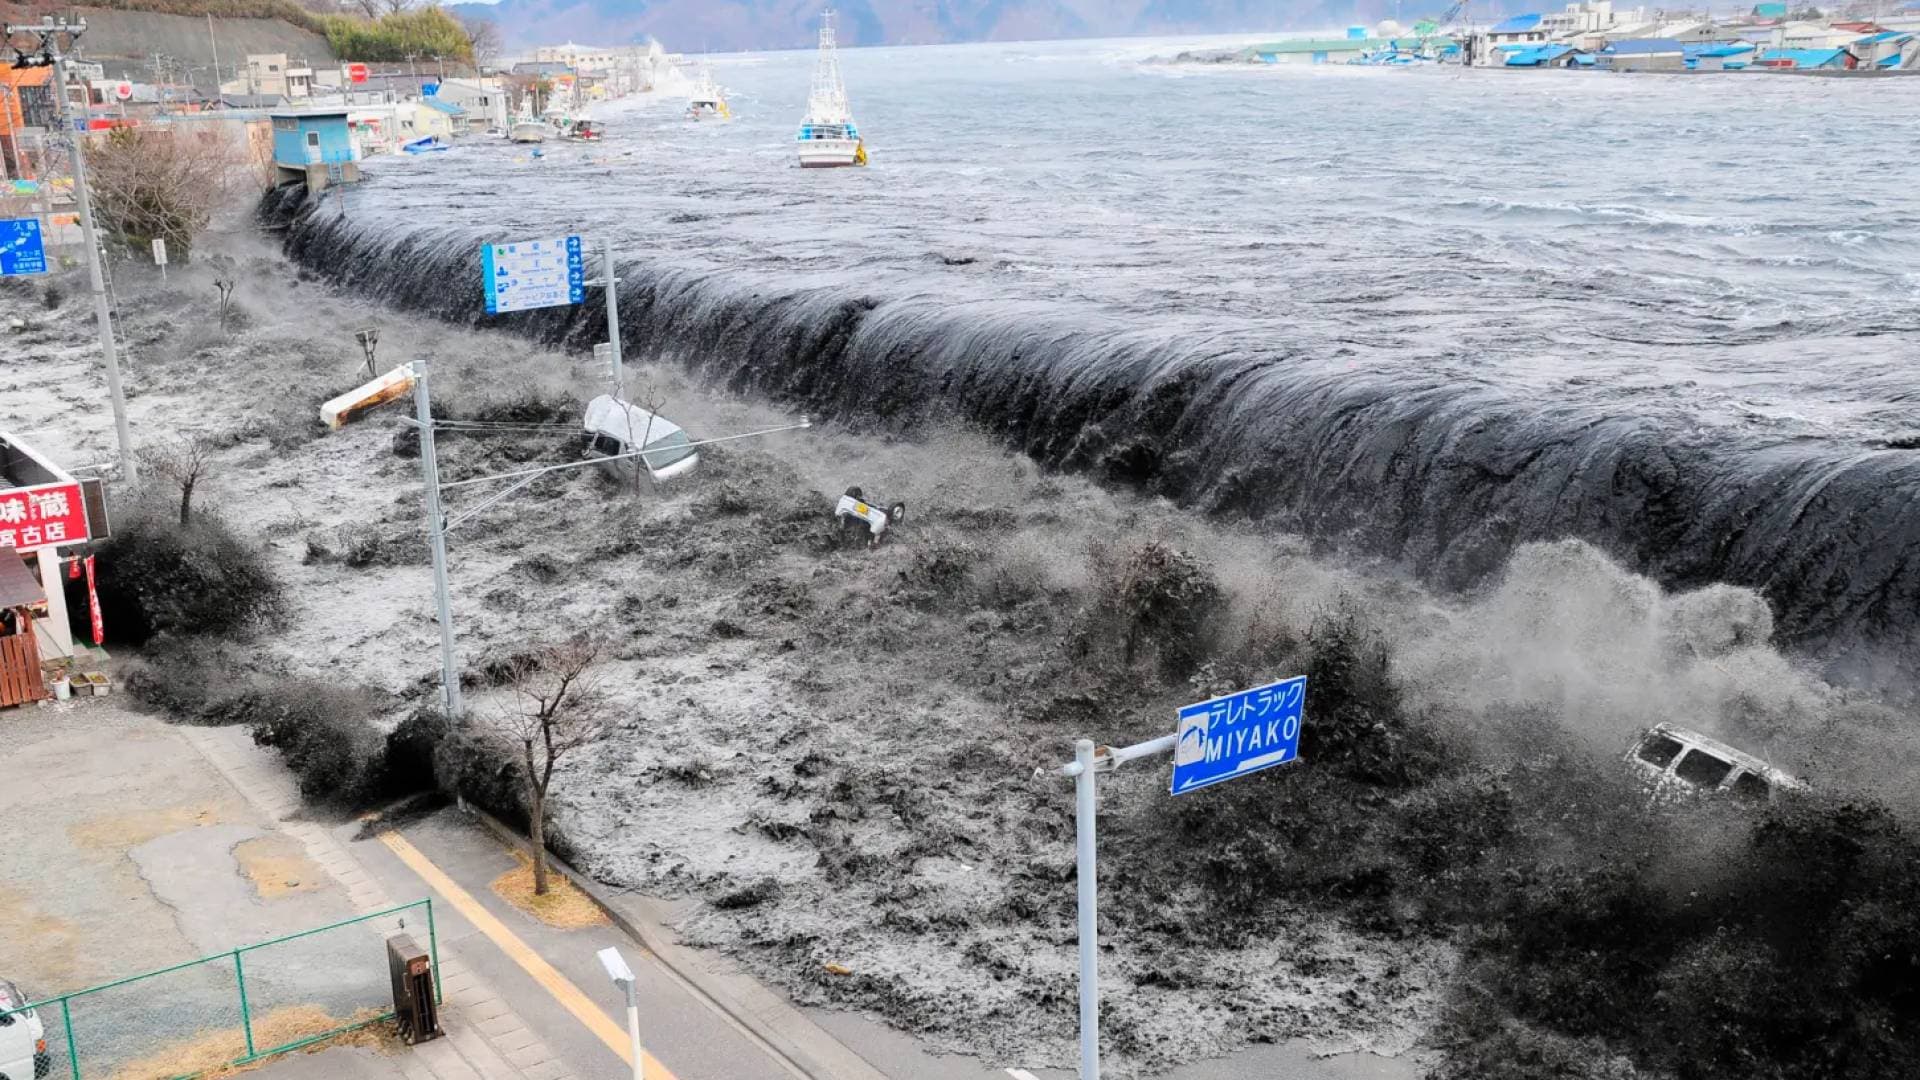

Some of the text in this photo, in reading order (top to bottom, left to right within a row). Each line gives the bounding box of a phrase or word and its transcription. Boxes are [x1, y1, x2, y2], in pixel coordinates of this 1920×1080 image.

[0, 521, 66, 547] 宮古店
[1210, 682, 1303, 730] テレトラック
[1206, 715, 1298, 764] MIYAKO
